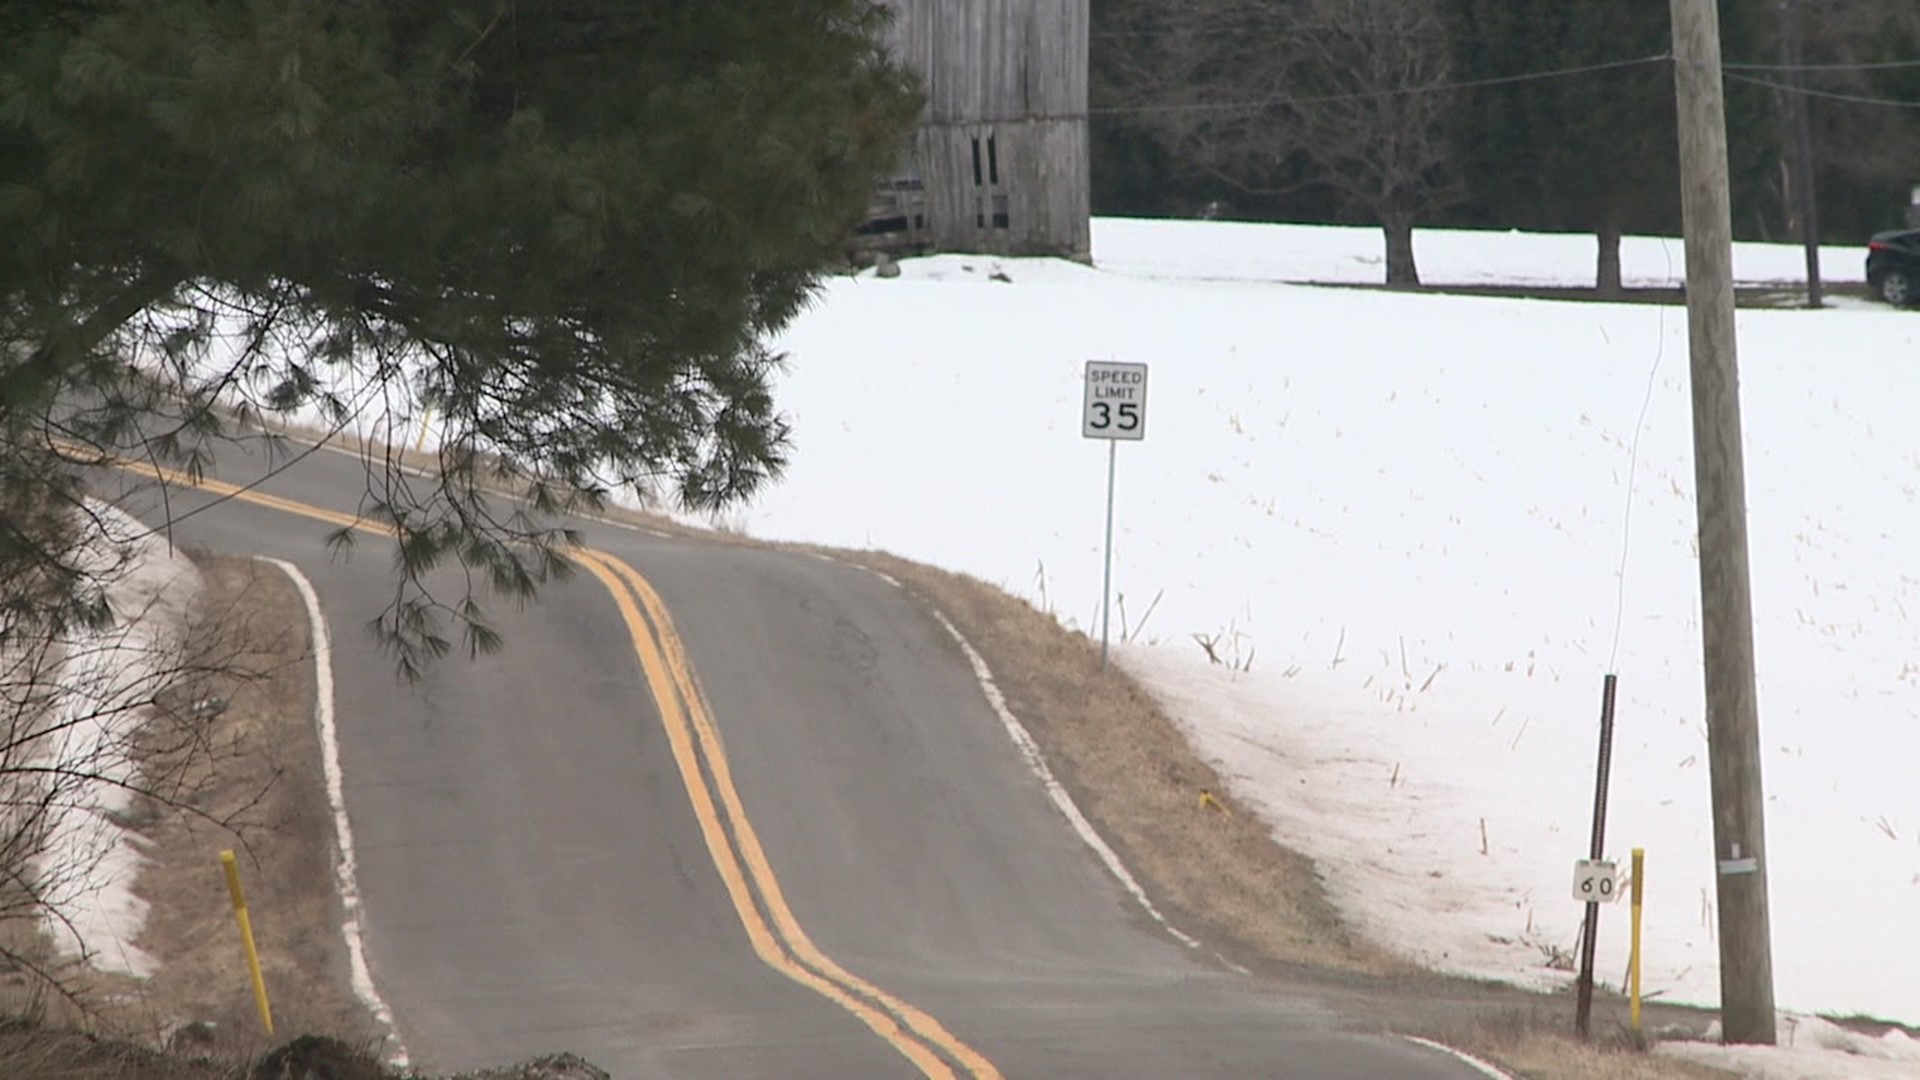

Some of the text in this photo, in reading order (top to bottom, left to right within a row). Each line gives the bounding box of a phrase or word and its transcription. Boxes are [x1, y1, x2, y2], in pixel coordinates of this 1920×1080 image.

[1091, 370, 1142, 384] SPEED
[1095, 386, 1135, 399] LIMIT
[1090, 402, 1138, 430] 35
[1581, 876, 1612, 895] 60
